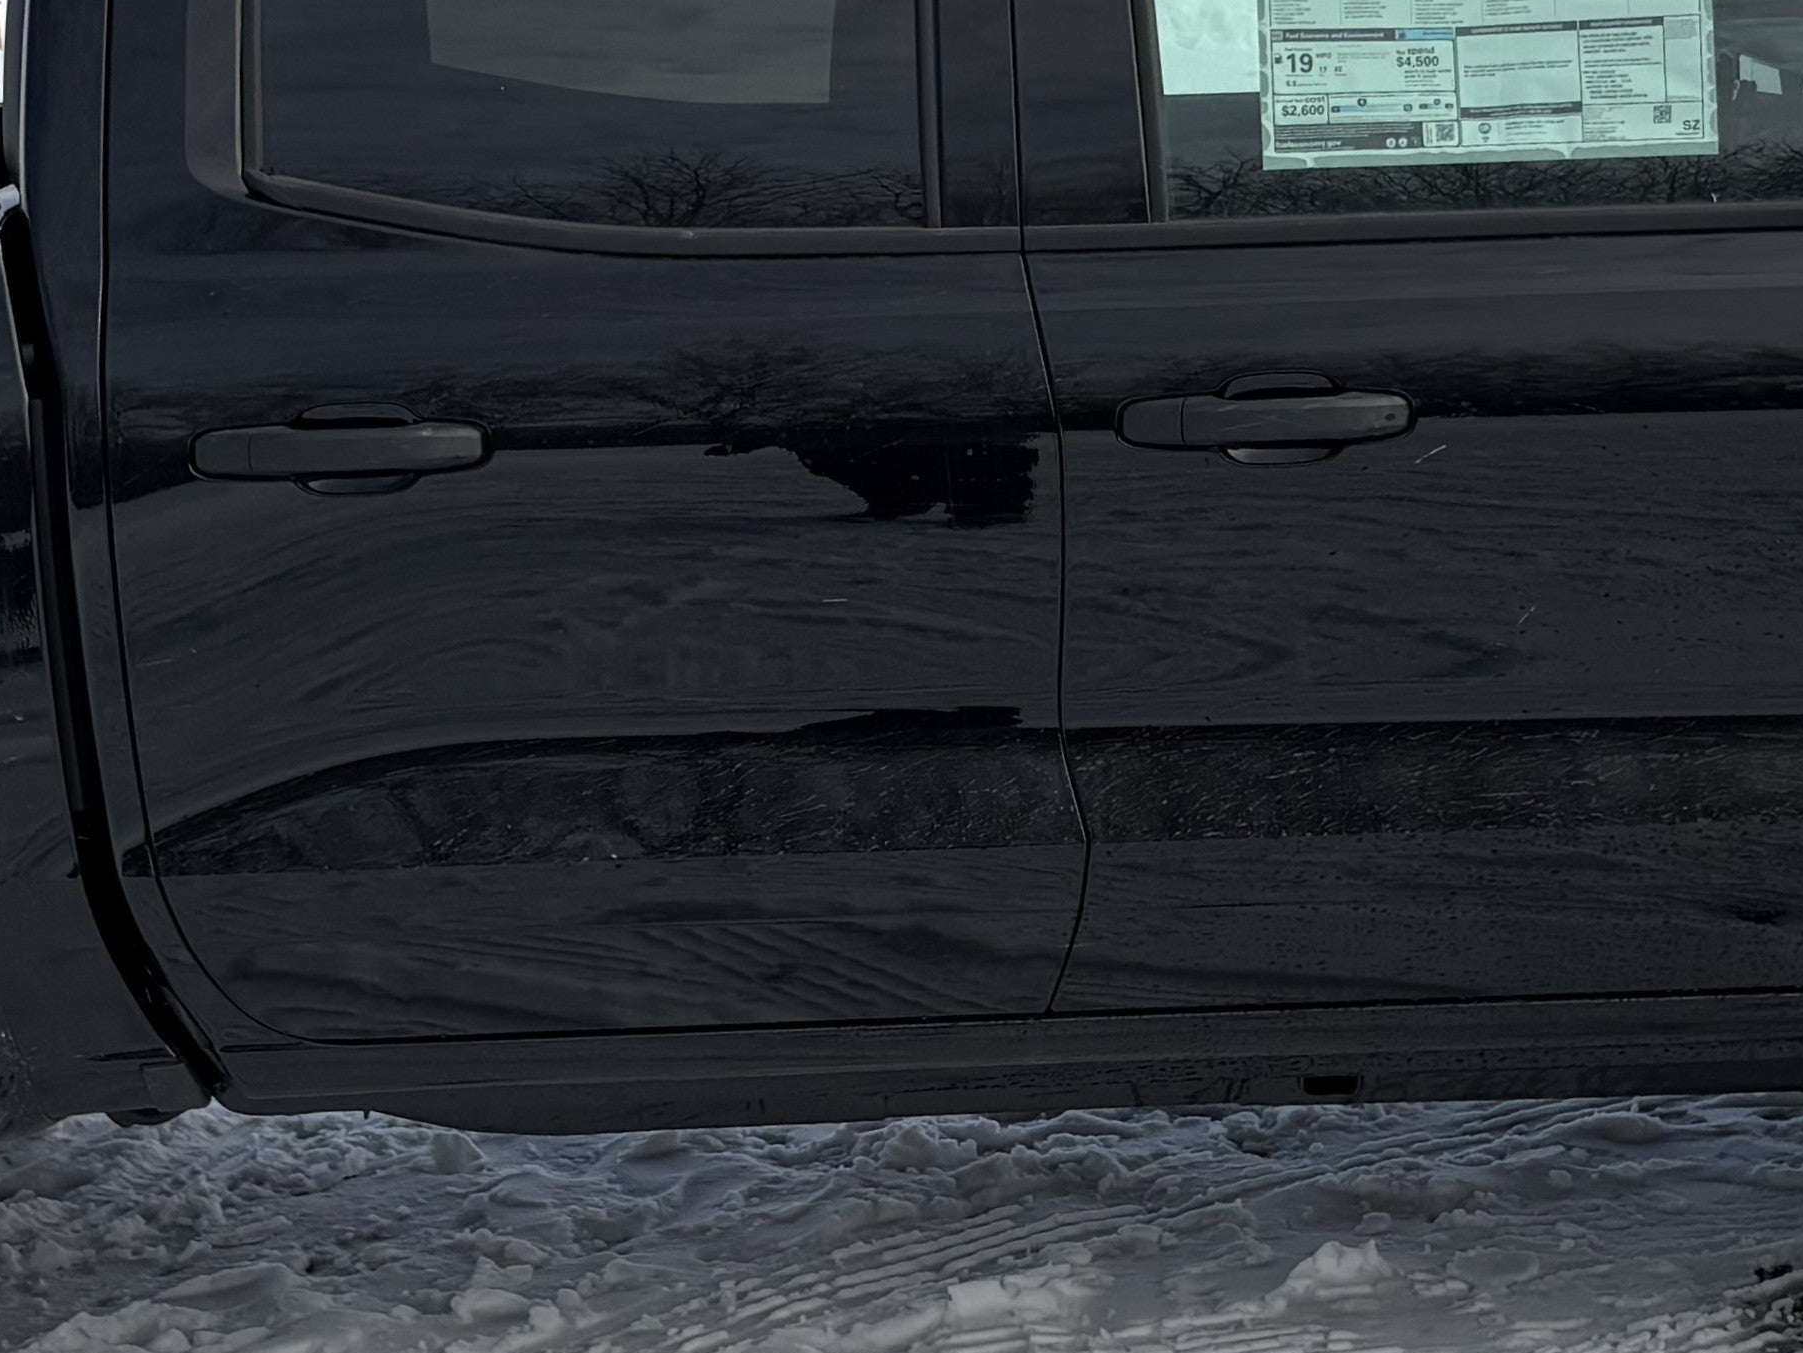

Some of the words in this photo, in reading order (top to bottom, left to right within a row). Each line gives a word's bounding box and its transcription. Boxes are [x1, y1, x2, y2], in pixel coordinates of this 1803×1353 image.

[1407, 46, 1435, 56] spend
[1286, 52, 1313, 74] 19
[1396, 55, 1439, 69] $4,500
[1281, 104, 1325, 117] $2,600
[1682, 119, 1701, 131] SZ
